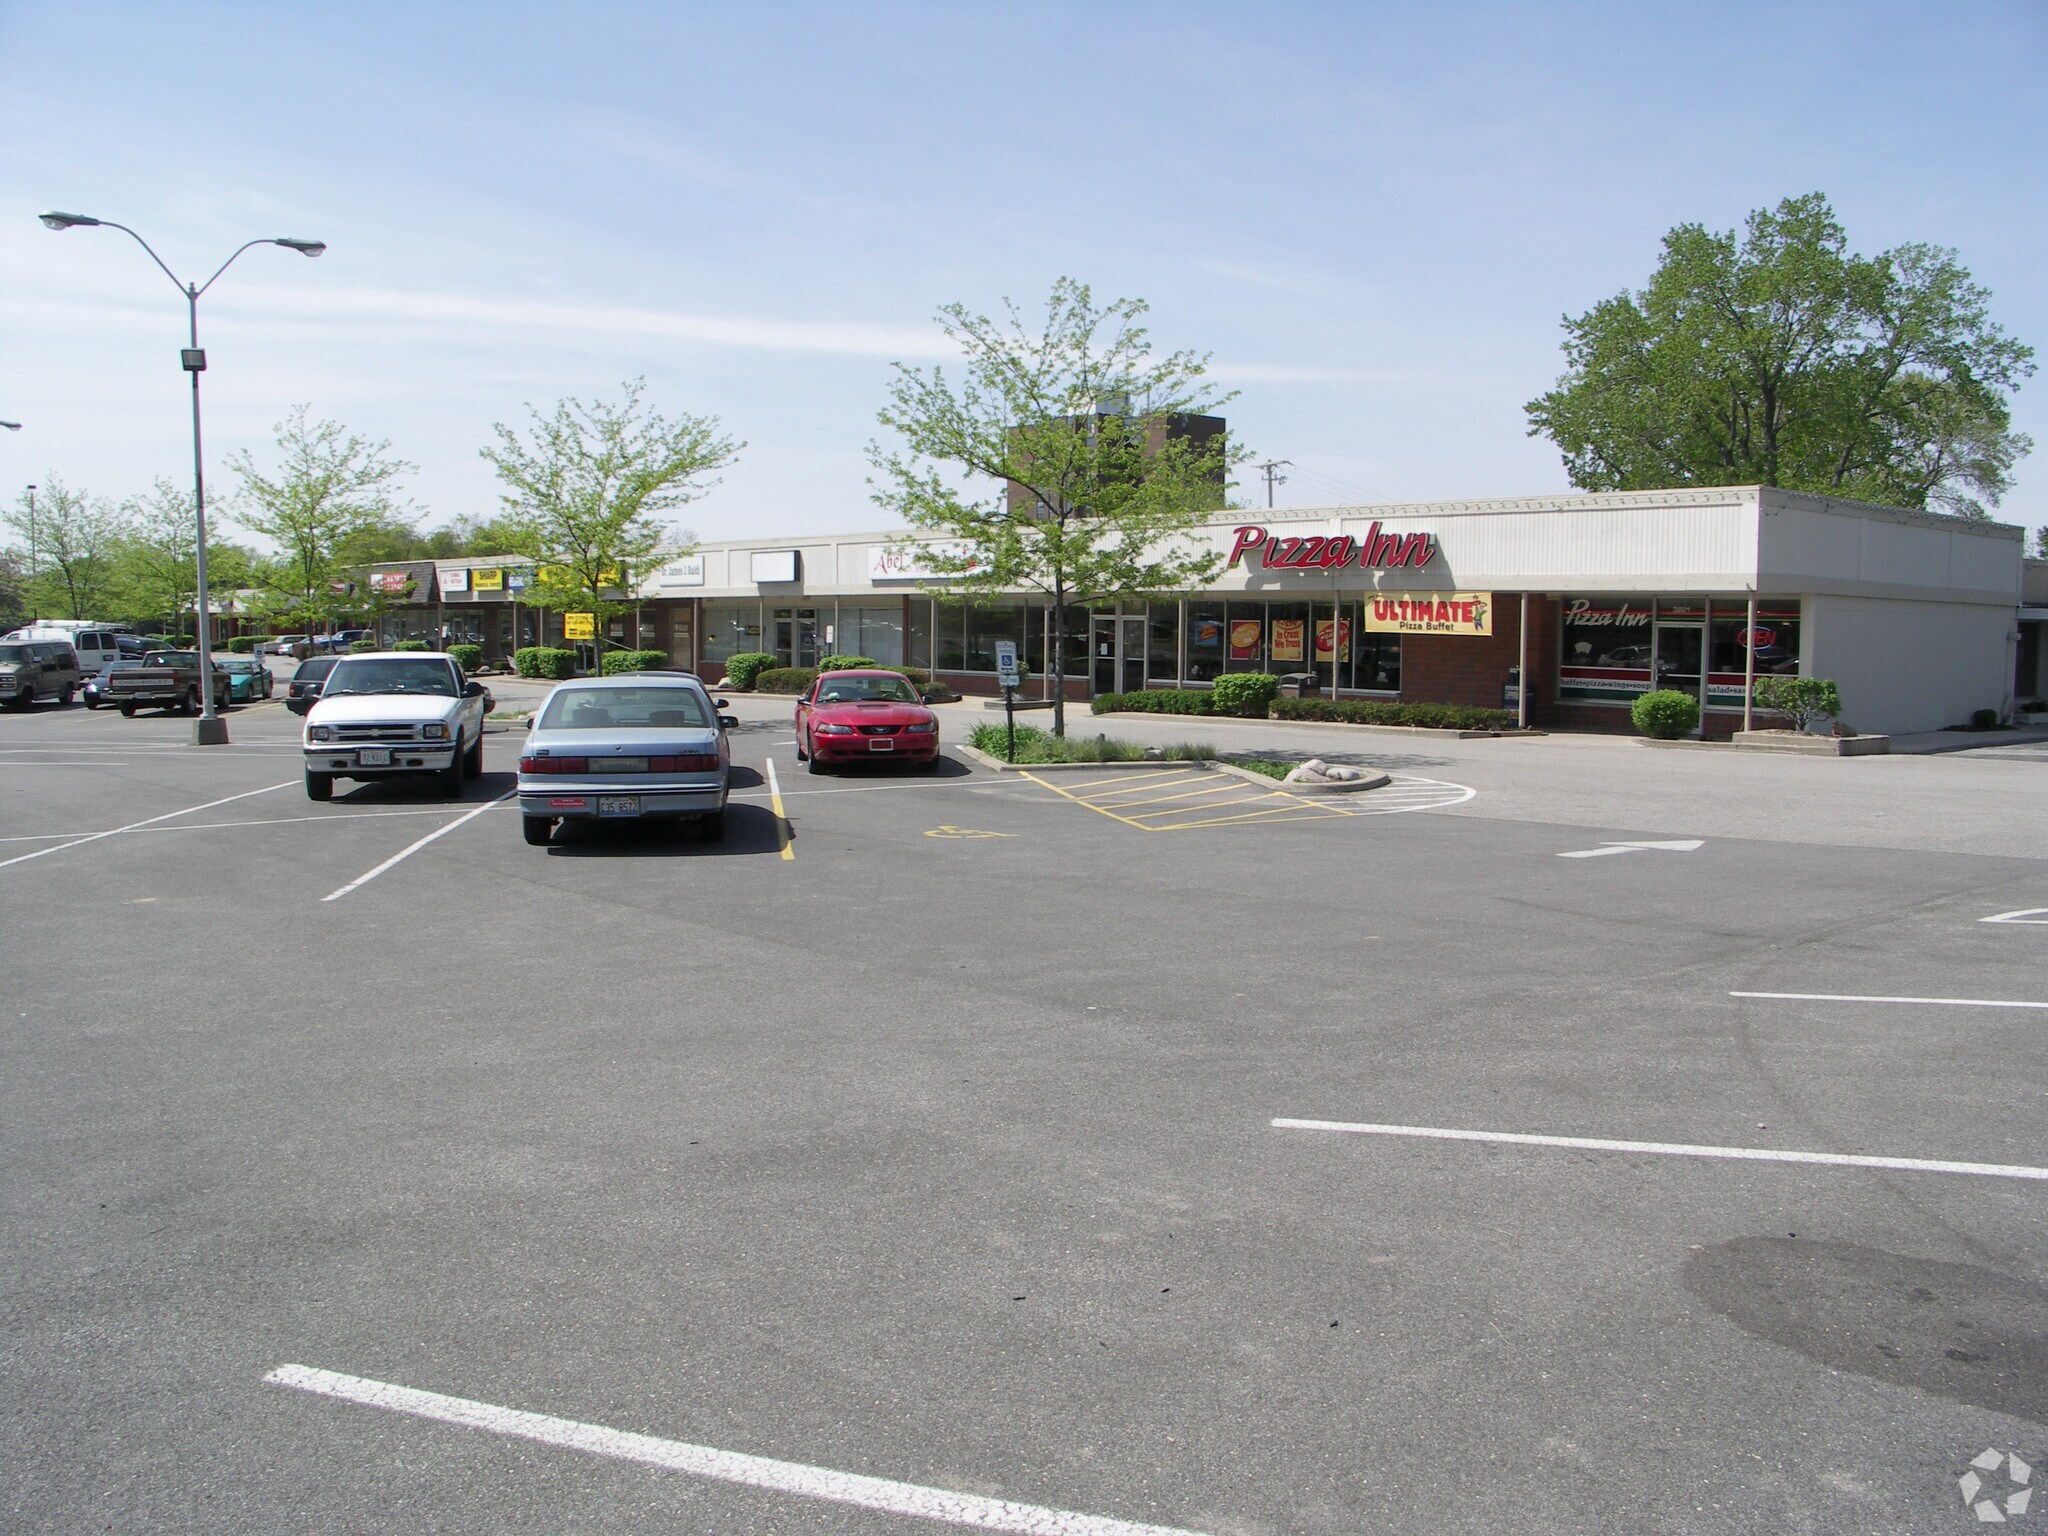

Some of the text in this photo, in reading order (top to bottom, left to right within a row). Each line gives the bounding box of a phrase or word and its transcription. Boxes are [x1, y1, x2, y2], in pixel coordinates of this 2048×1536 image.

[1227, 521, 1435, 569] Pizza Inn
[1374, 600, 1474, 622] ULTIMATE
[1565, 599, 1649, 627] Pizza Inn
[1400, 621, 1454, 631] Pizza Buffet
